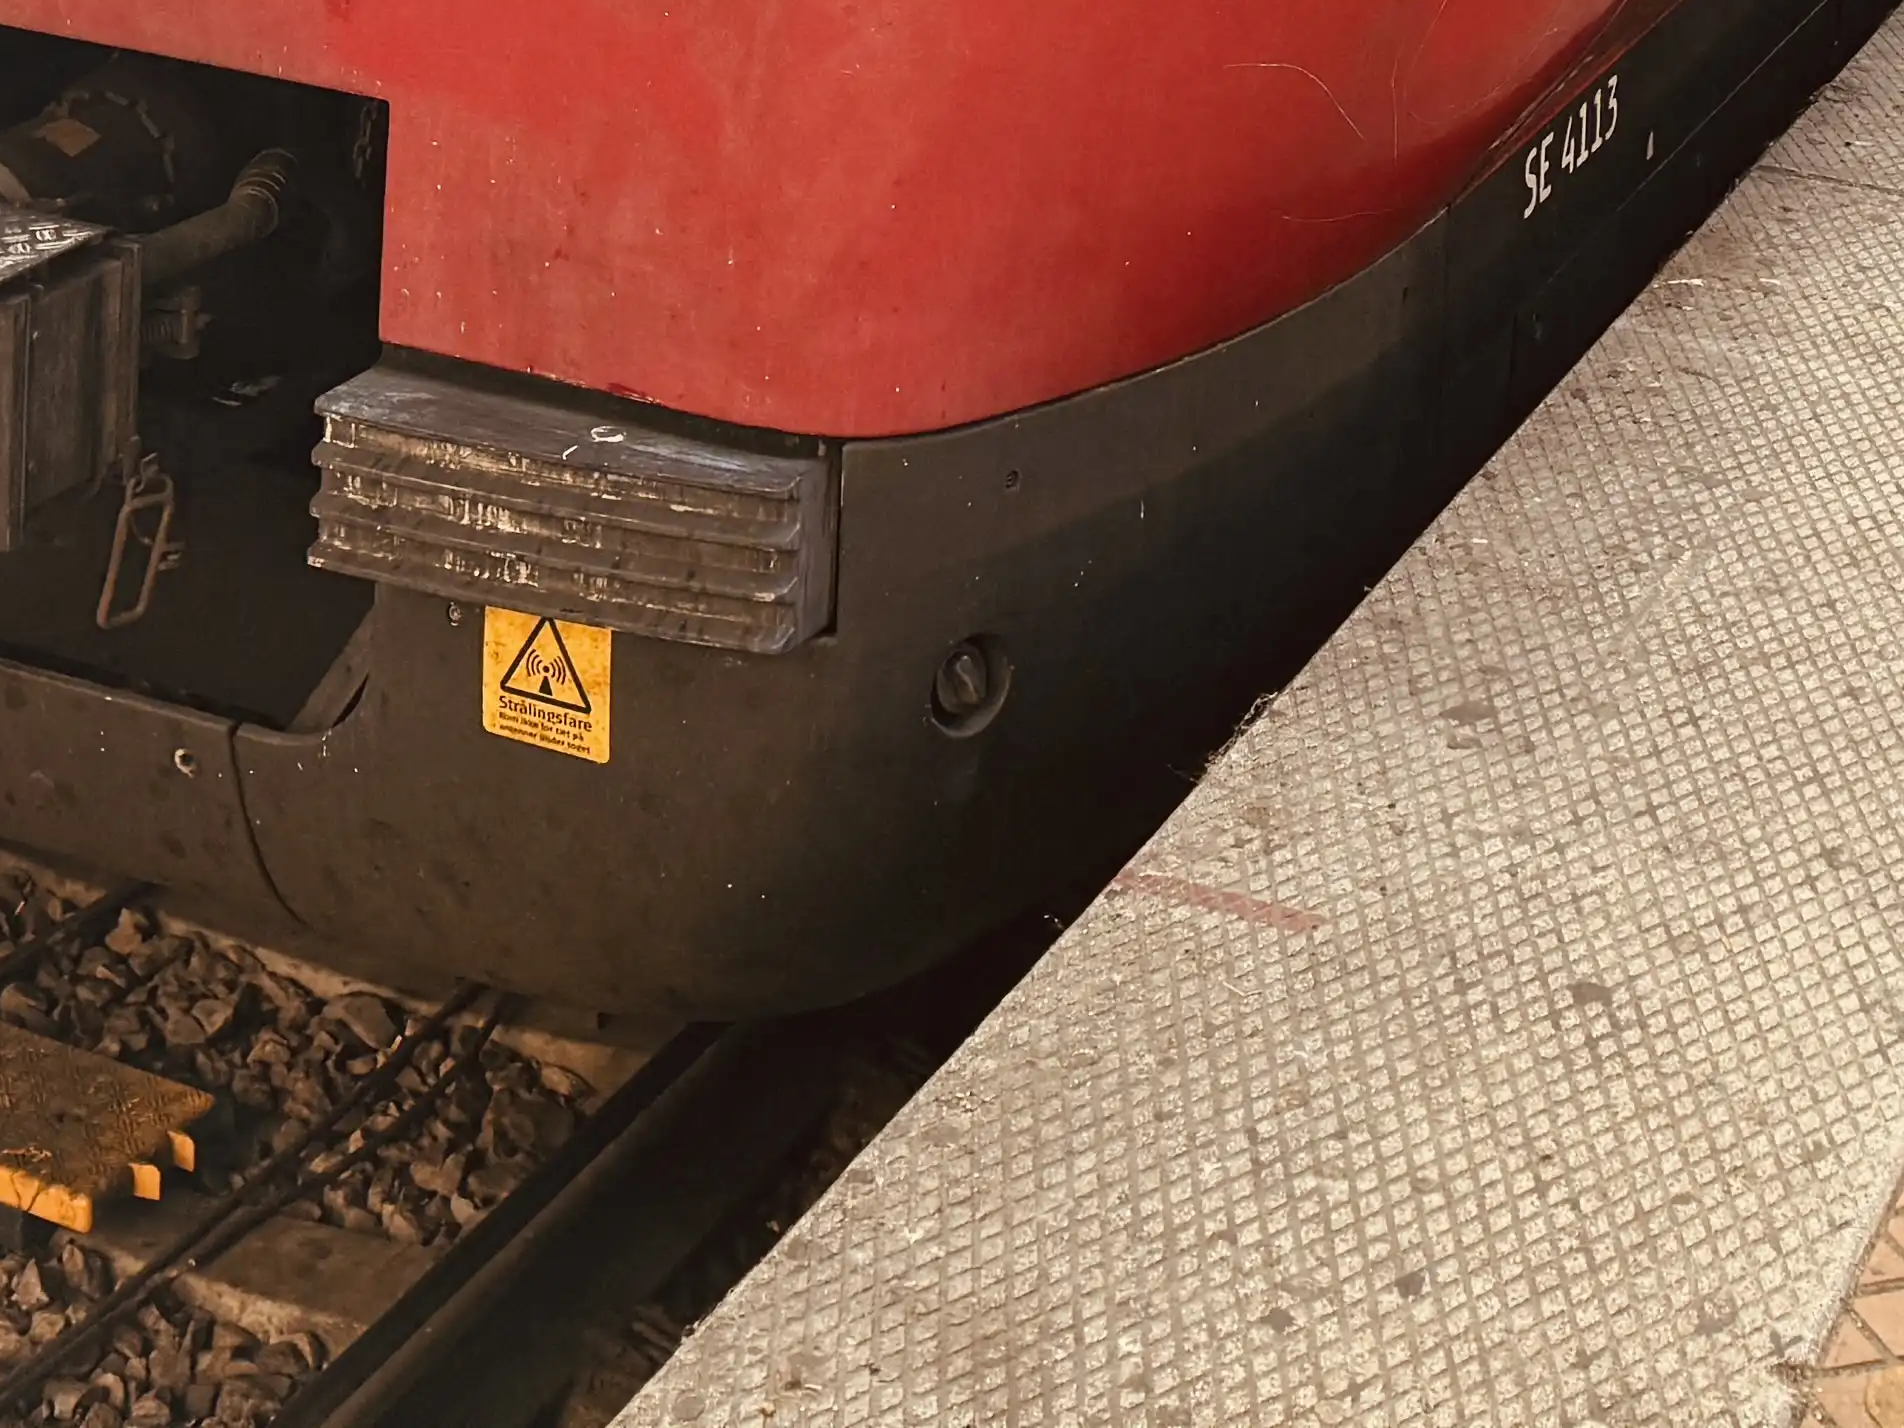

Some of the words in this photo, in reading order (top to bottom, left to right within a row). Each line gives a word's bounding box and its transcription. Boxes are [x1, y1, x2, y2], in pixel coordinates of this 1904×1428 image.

[1523, 132, 1554, 219] SE
[1561, 74, 1618, 174] 4113
[499, 695, 592, 732] Strålingsfare
